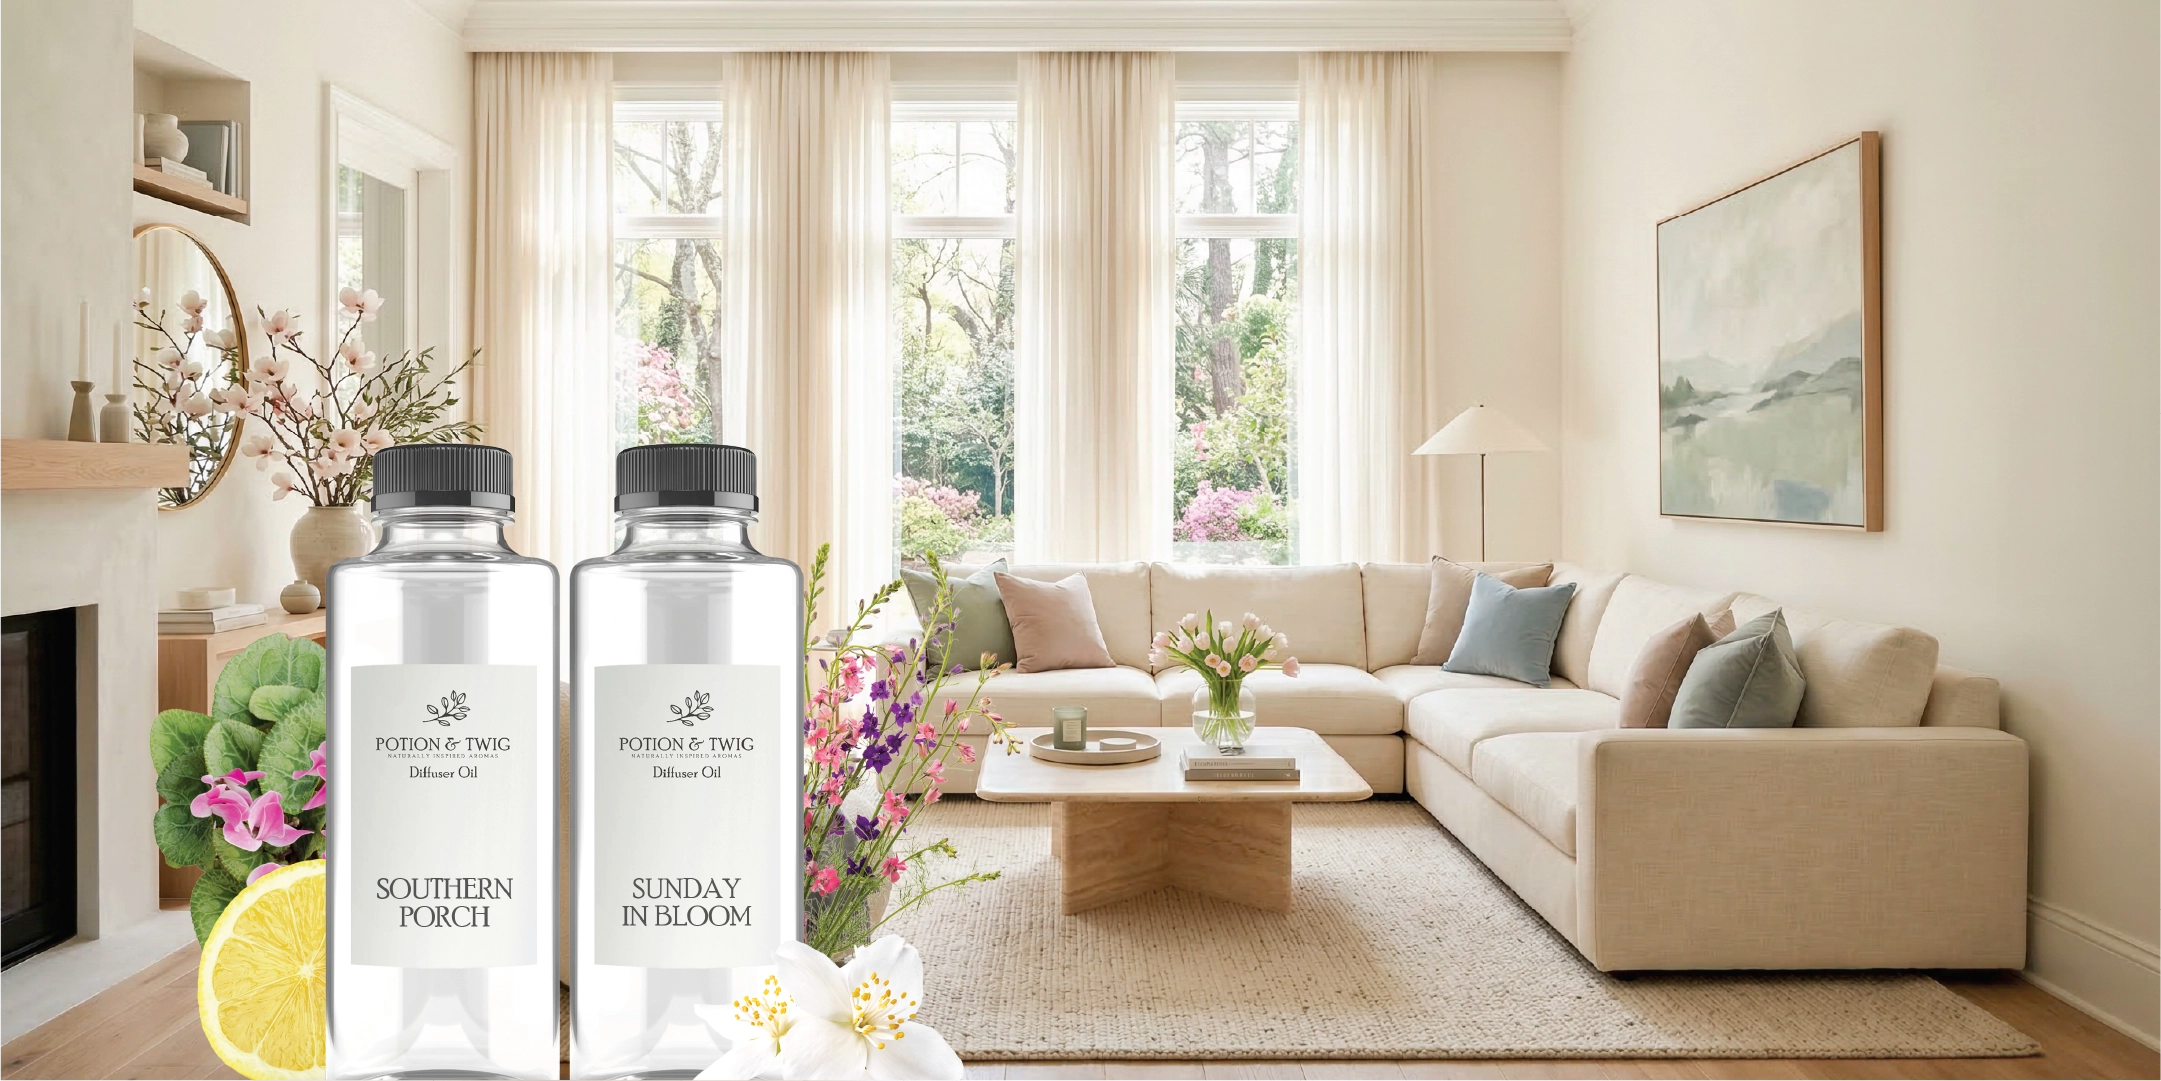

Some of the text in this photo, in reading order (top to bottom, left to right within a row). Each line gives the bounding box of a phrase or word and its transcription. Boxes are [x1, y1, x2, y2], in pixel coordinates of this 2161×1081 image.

[375, 737, 511, 751] POTION & TWIG
[619, 737, 754, 751] POTION & TWIG
[409, 765, 478, 779] Diffuser Oil
[653, 765, 722, 779] Diffuser Oil
[376, 877, 514, 900] SOUTHERN
[632, 877, 742, 900] SUNDAY
[399, 905, 490, 928] PORCH
[622, 905, 752, 927] IN BLOOM
